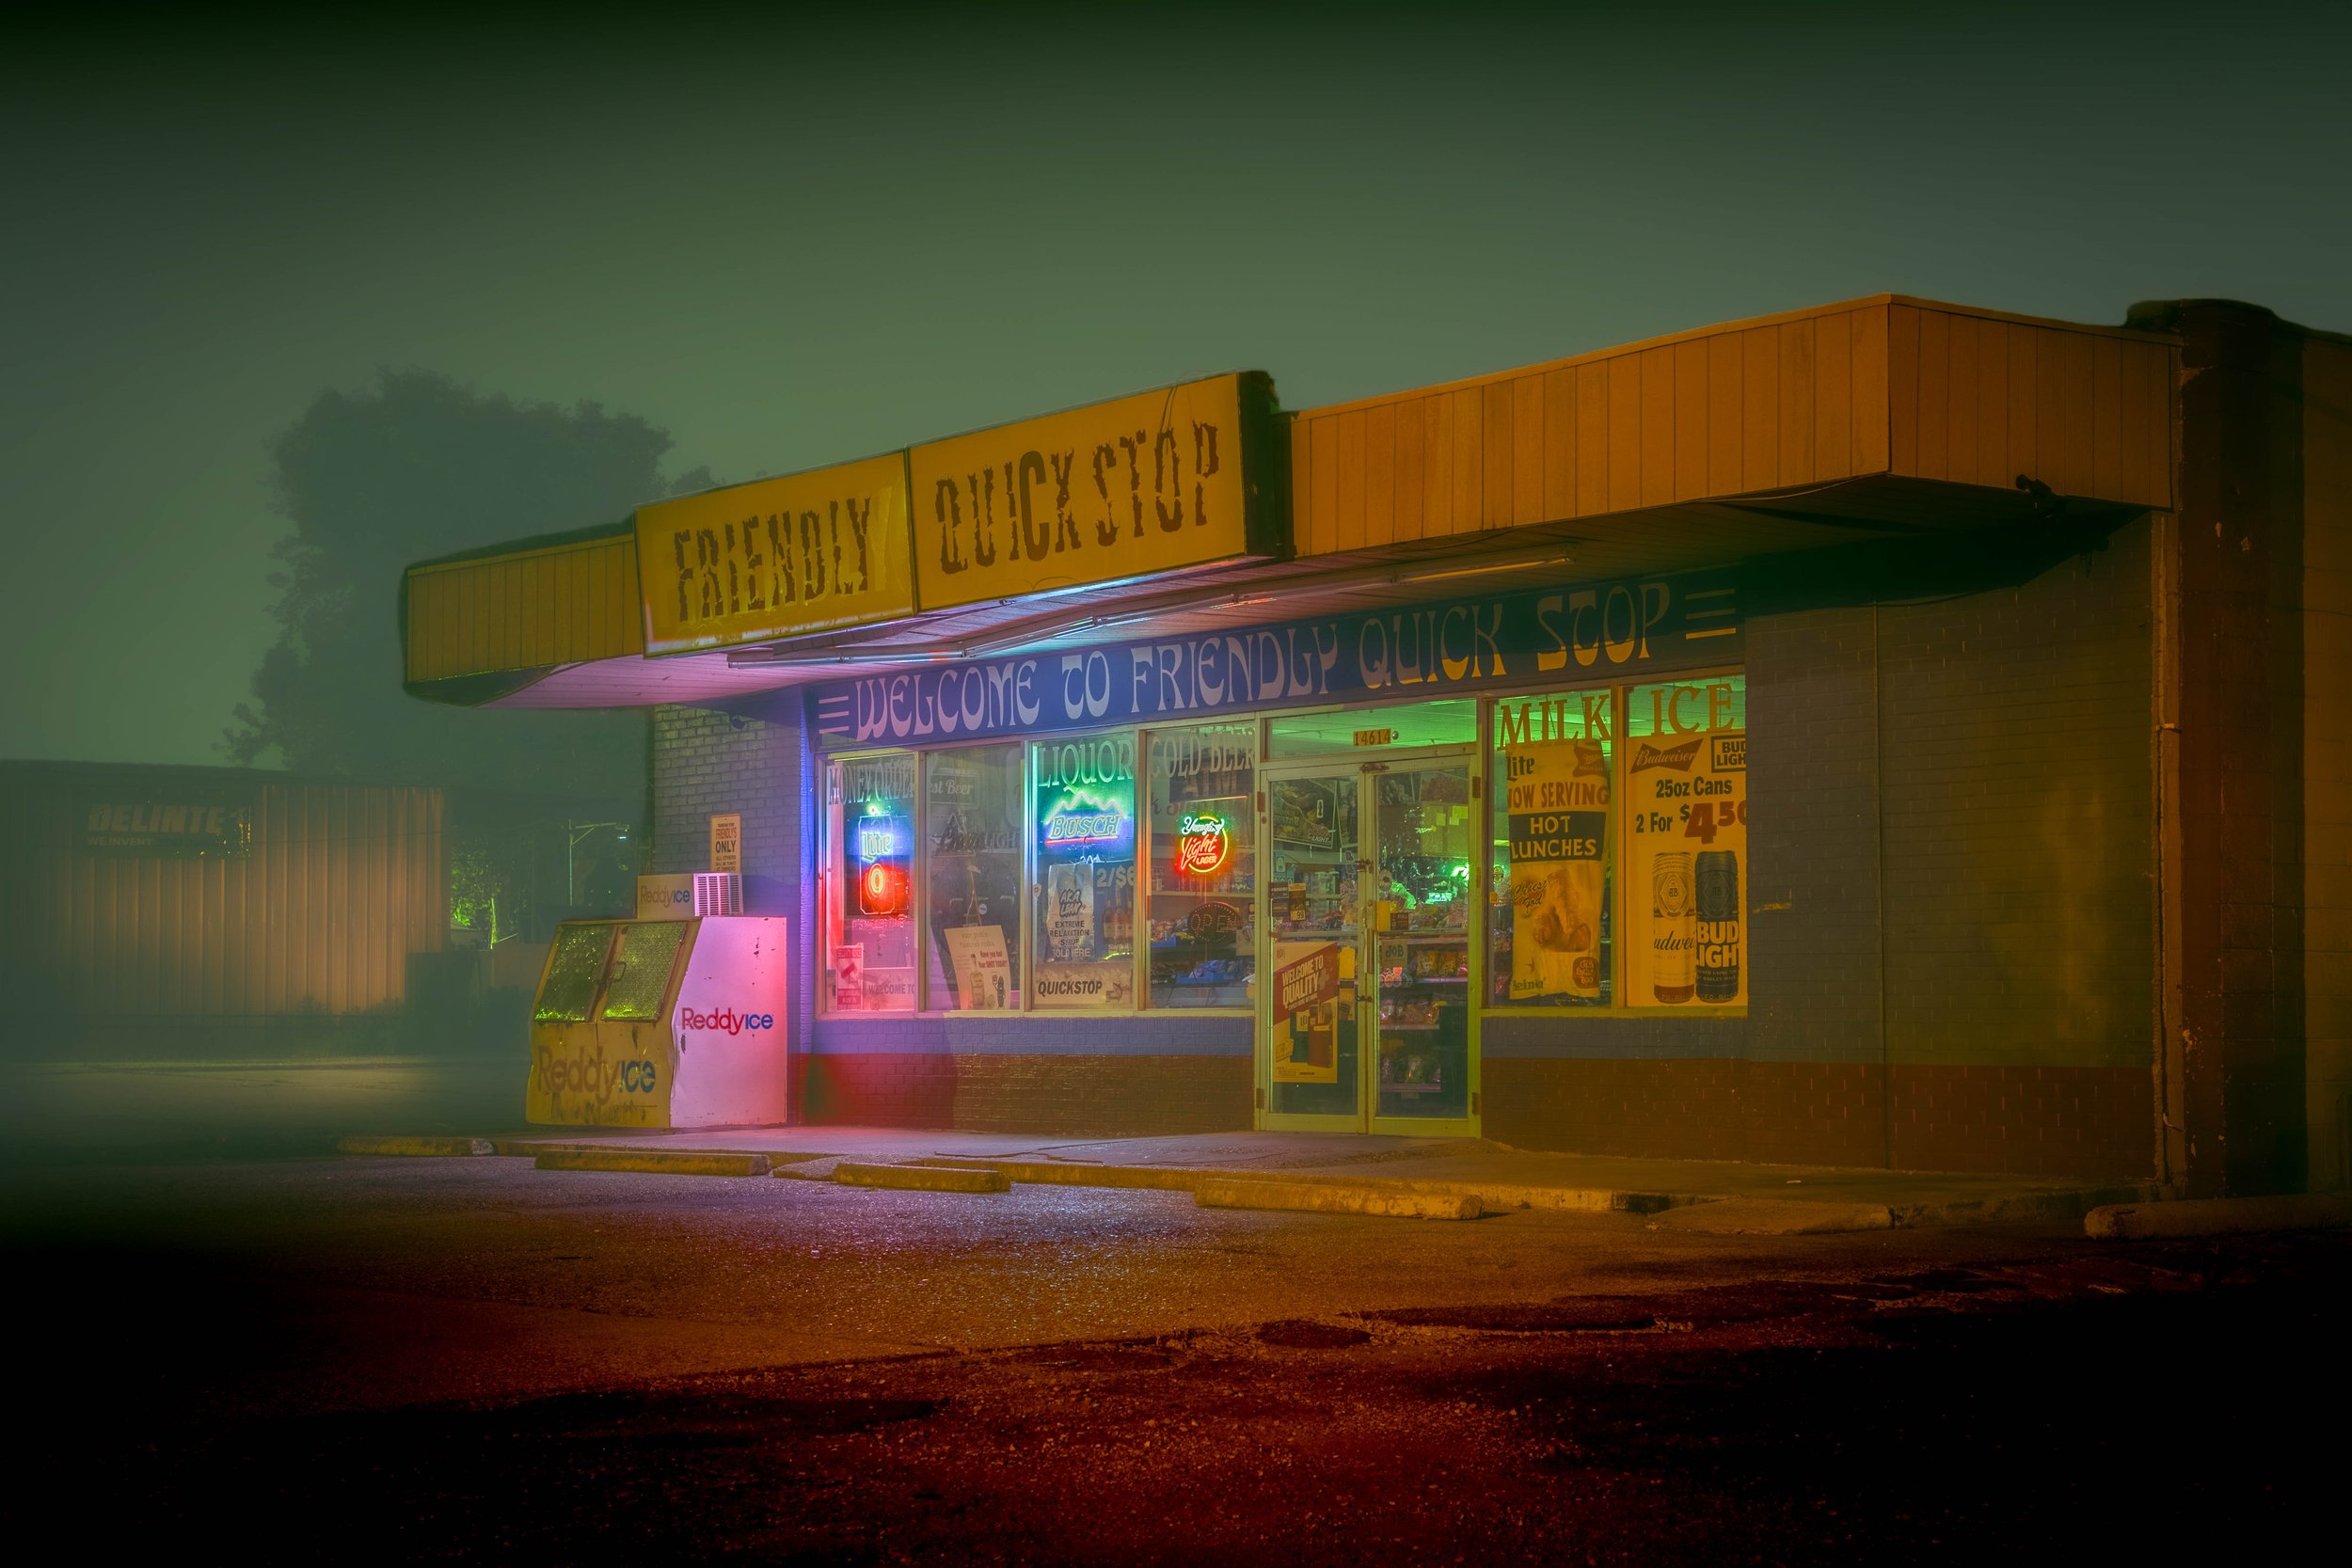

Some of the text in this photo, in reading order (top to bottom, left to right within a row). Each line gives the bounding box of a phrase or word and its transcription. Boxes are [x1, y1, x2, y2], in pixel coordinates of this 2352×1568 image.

[935, 420, 1219, 575] QUICK STOP
[674, 497, 870, 622] FRIENDLY
[855, 582, 1670, 741] WELCOME TO FRIENDLY QUICK STOP
[1650, 683, 1735, 736] ICE
[1497, 694, 1611, 751] MILK
[1354, 730, 1391, 746] 14614
[1722, 741, 1746, 753] BUD
[1039, 739, 1134, 794] LIQUOR
[1151, 735, 1202, 780] COLD
[1637, 749, 1696, 767] Budweiser
[1541, 782, 1610, 809] SERVING
[1656, 776, 1733, 799] 25oz Cans
[1050, 814, 1121, 838] BUSCH
[1530, 816, 1572, 835] HOT
[1636, 814, 1645, 833] 2
[1650, 812, 1673, 833] For
[87, 837, 107, 847] WE
[108, 837, 153, 847] INVENT
[715, 840, 737, 853] ONLY
[861, 832, 893, 863] Lite
[1511, 838, 1597, 860] LUNCHES
[1197, 855, 1217, 865] LAGER
[1055, 920, 1085, 928] EXTREME
[1697, 921, 1739, 944] BUD
[1385, 944, 1405, 958] JOB
[1281, 954, 1324, 985] WELCOME TO
[868, 984, 904, 995] WELCOME
[1038, 981, 1103, 997] QUICKSTOP
[1282, 973, 1319, 1009] QUALITY
